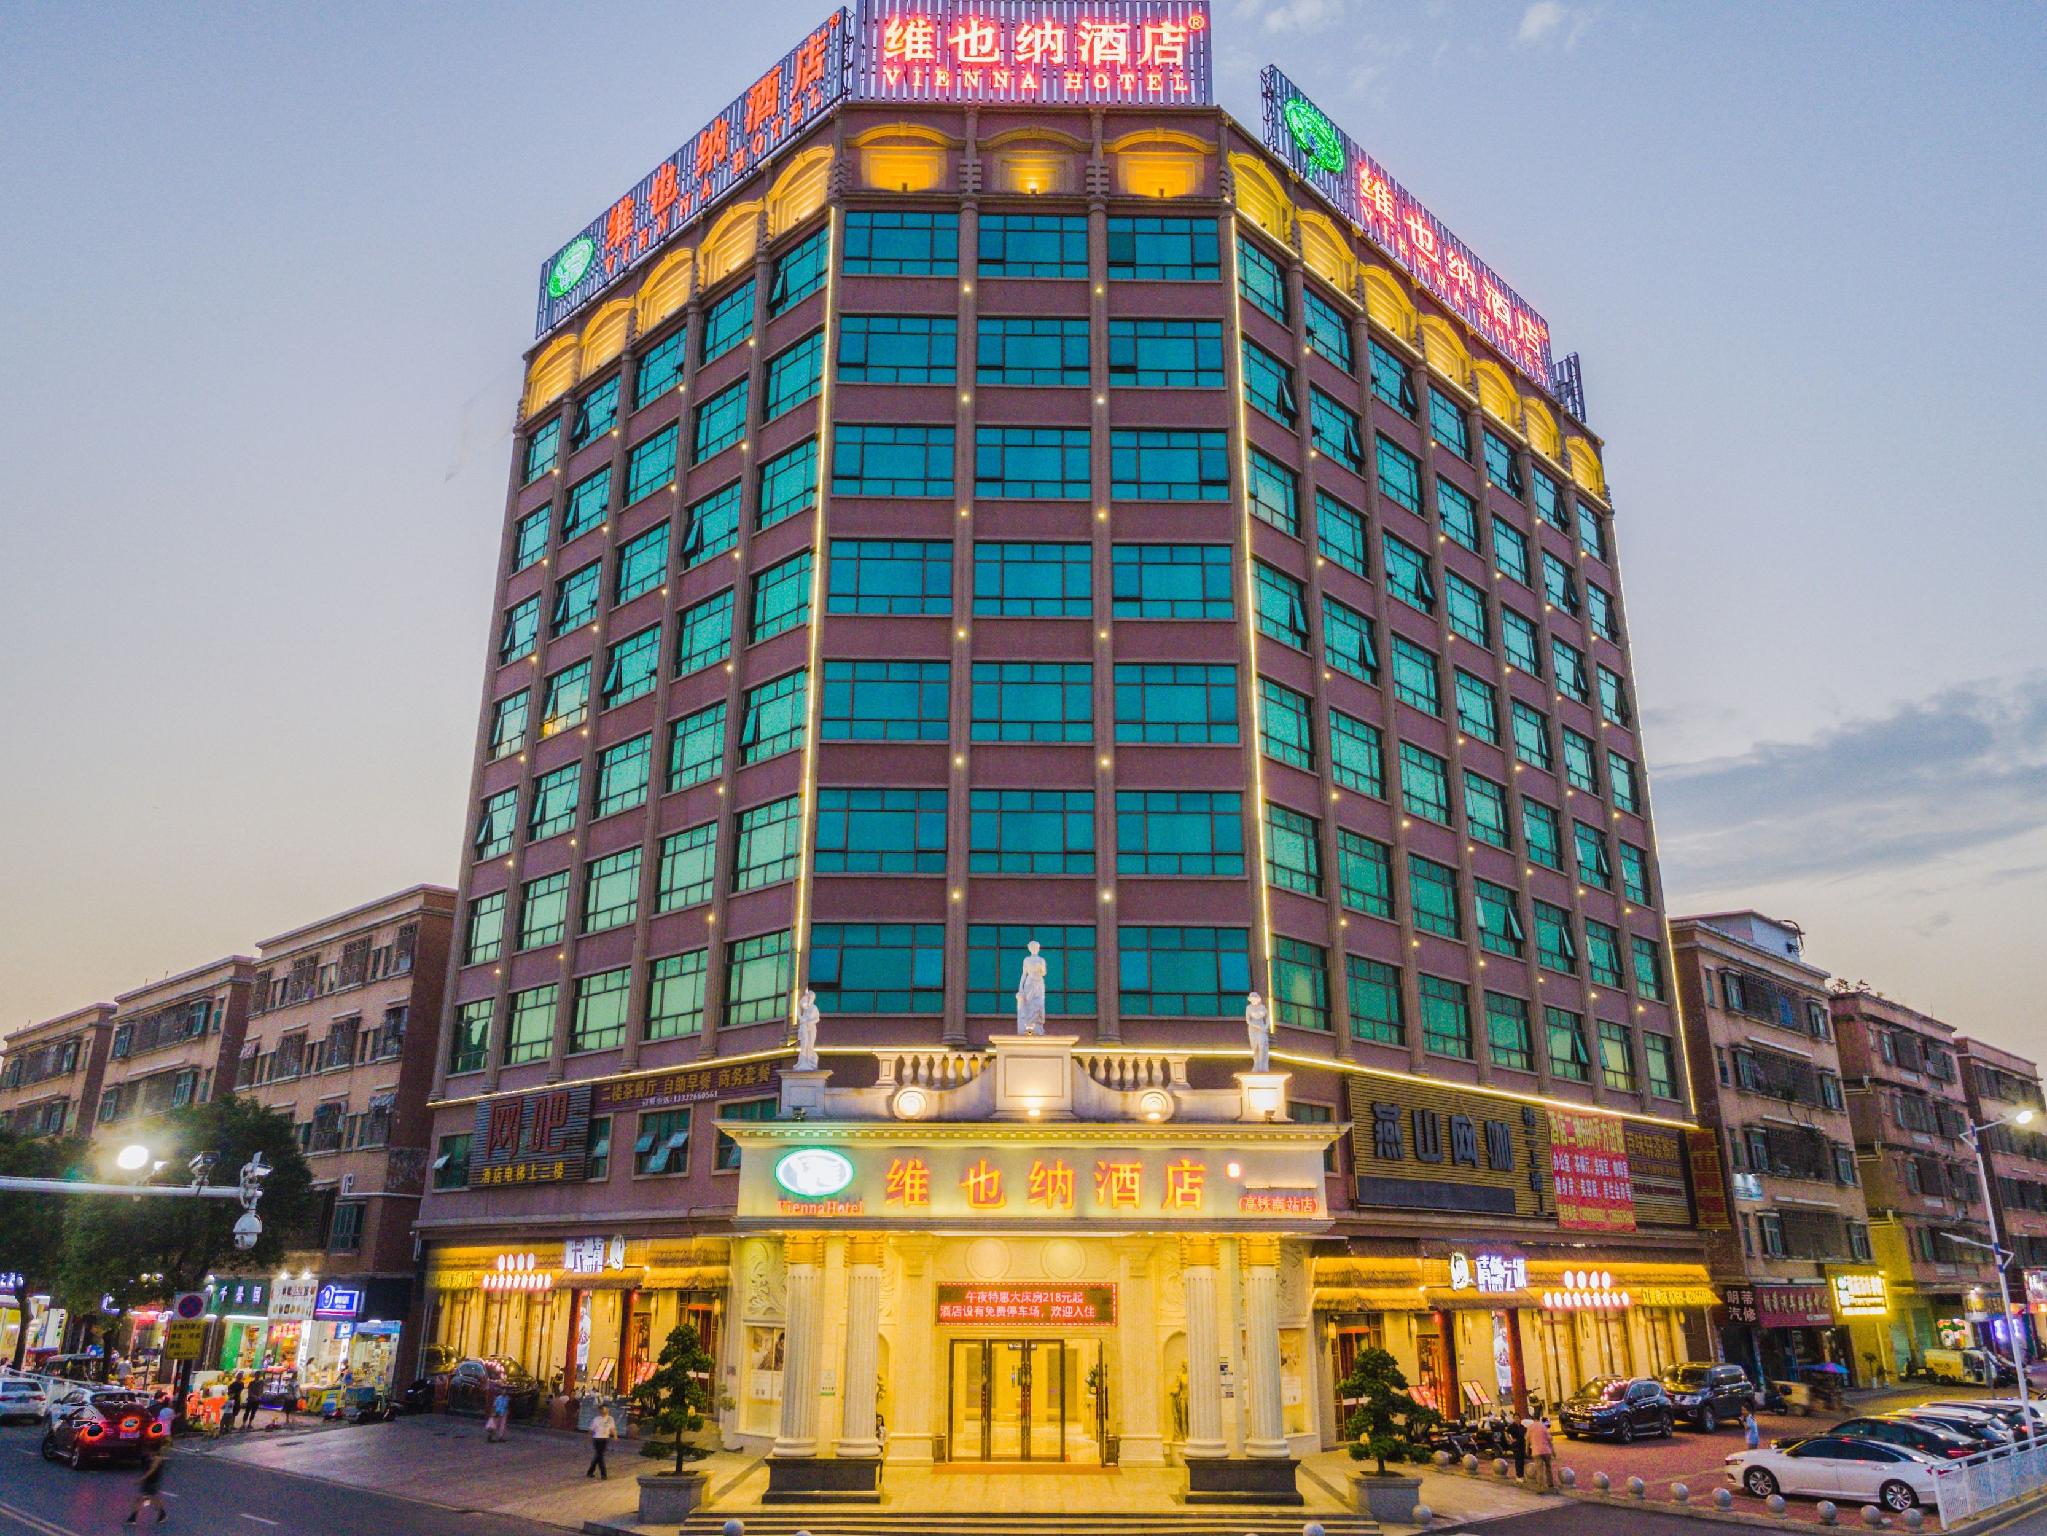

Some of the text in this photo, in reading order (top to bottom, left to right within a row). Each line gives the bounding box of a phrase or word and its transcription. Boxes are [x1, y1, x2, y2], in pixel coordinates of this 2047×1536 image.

[884, 18, 1189, 66] 维也纳酒店
[886, 70, 1188, 92] VIENNA HOTEL
[605, 28, 829, 251] 维也纳酒店
[605, 88, 822, 273] VIENNA HOTEL
[1359, 161, 1543, 357] 维也纳酒店
[484, 1090, 569, 1159] 网吧
[885, 1158, 1207, 1210] 维也纳酒店
